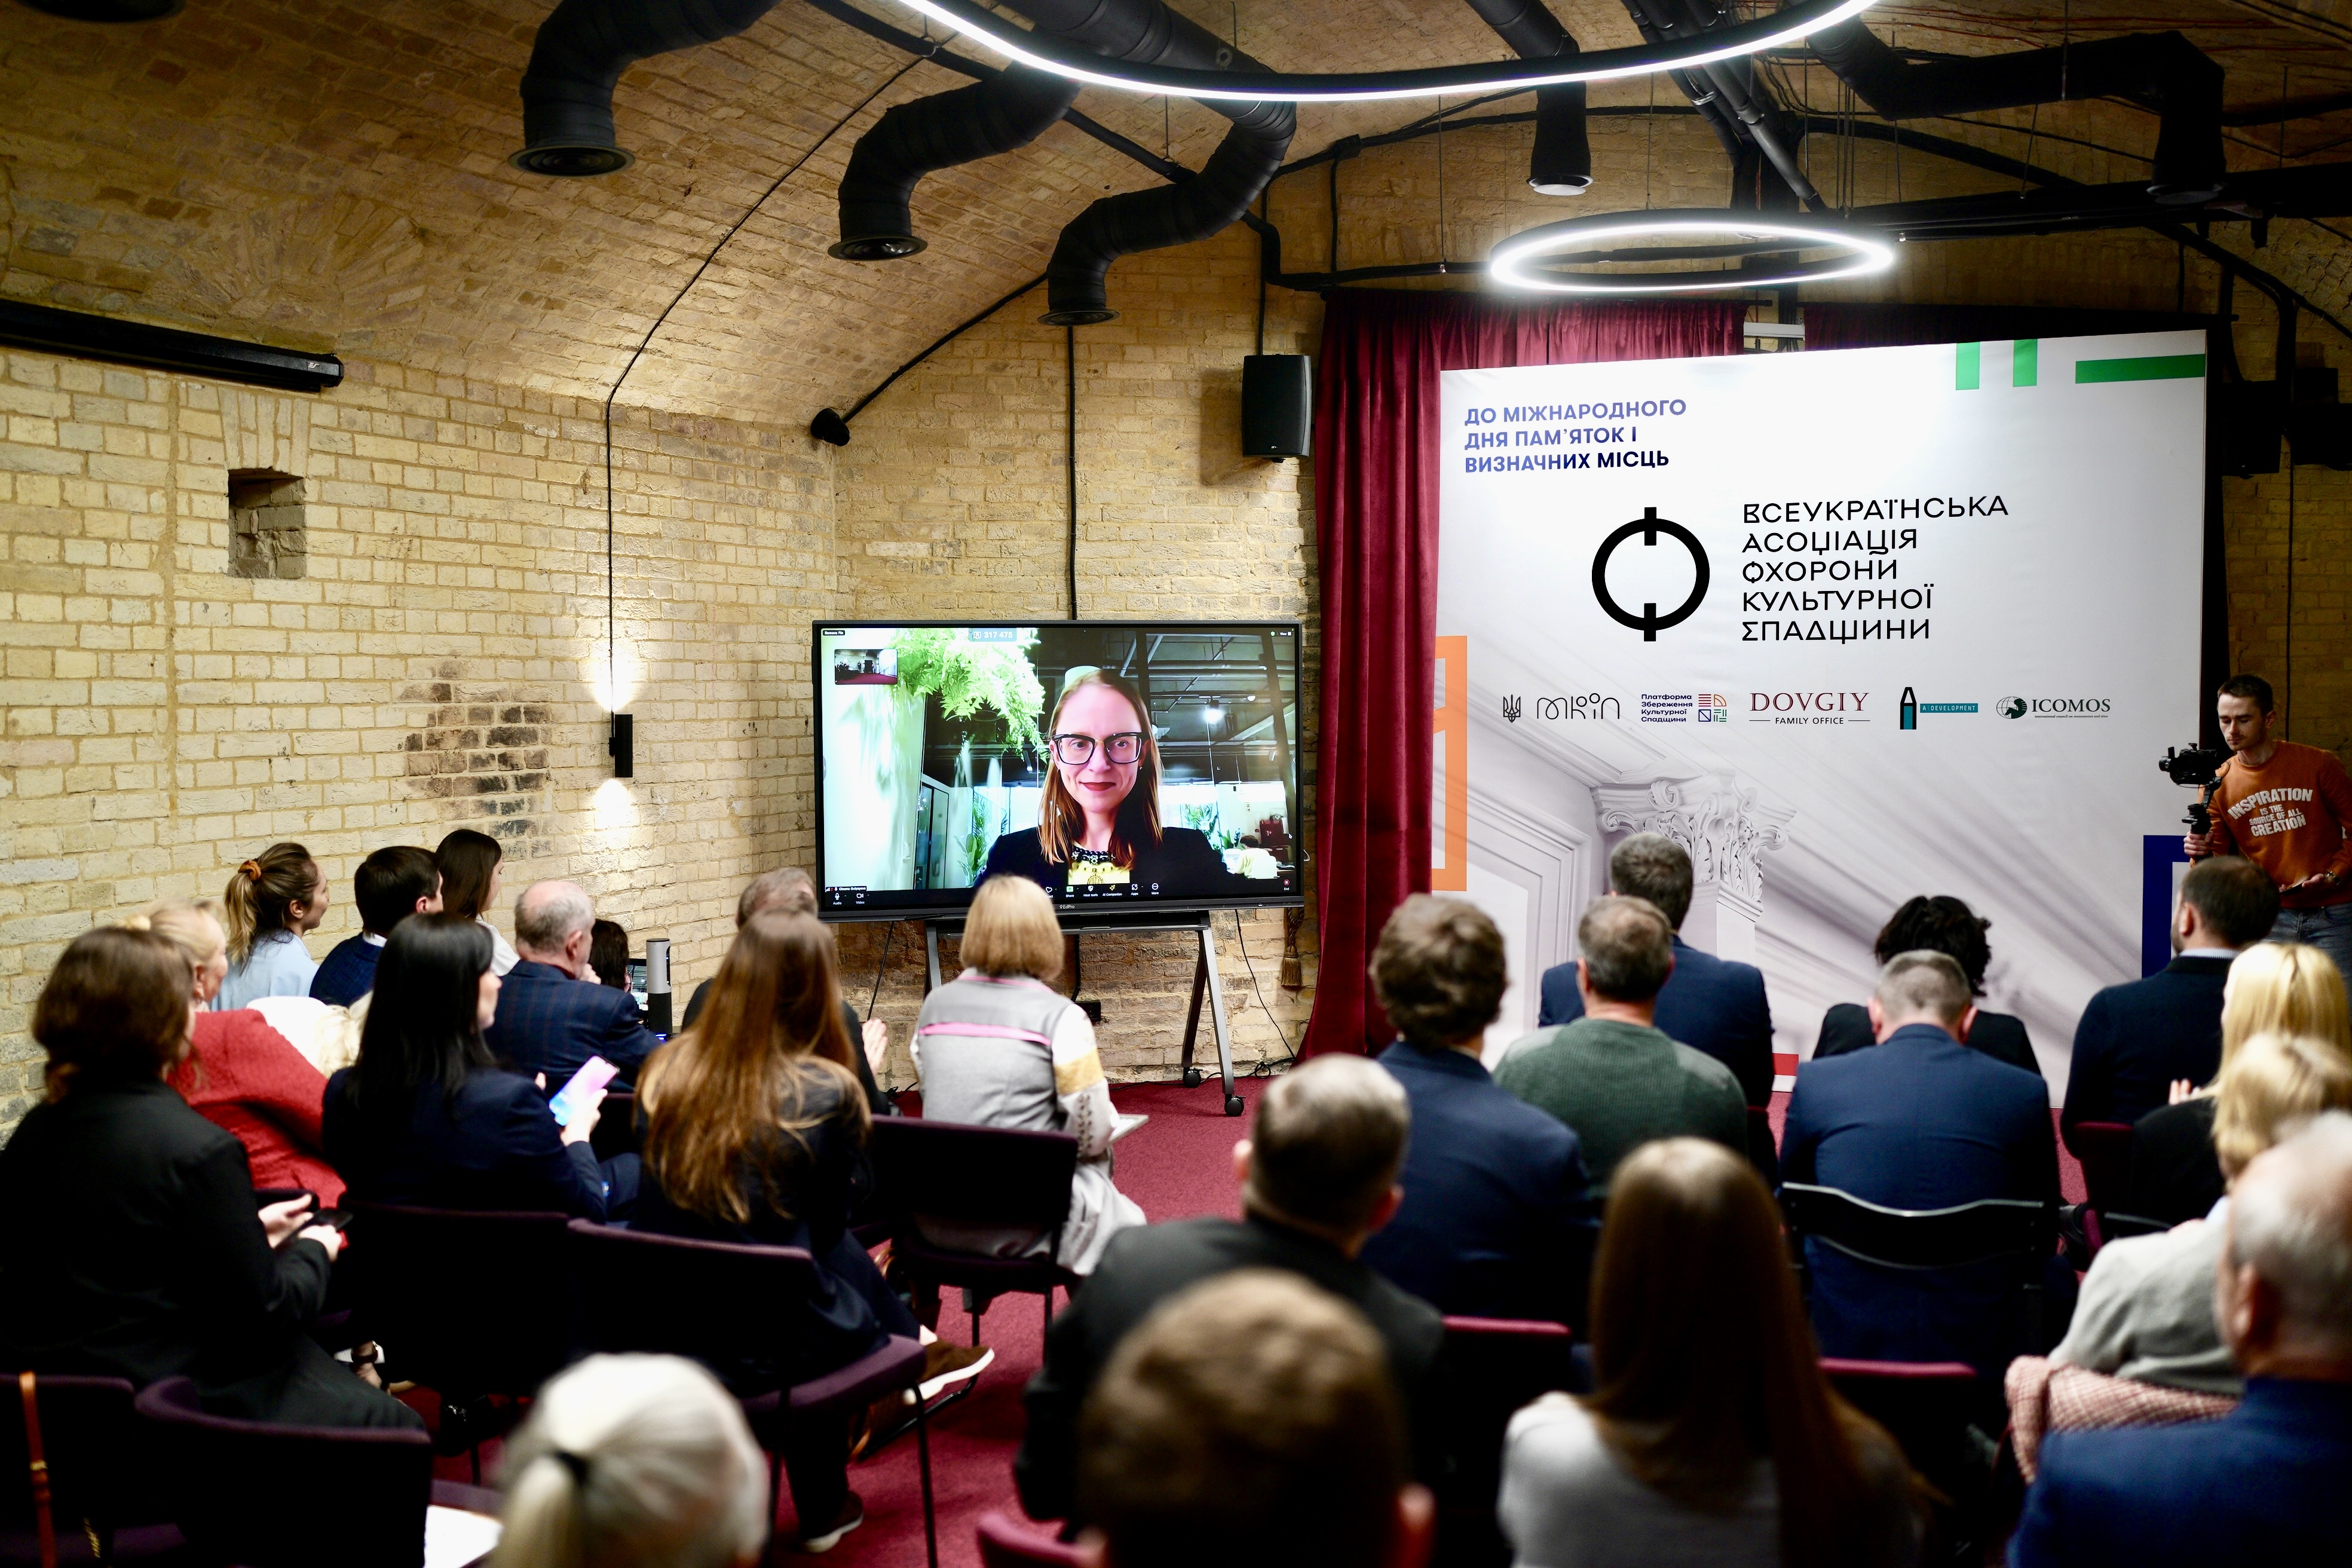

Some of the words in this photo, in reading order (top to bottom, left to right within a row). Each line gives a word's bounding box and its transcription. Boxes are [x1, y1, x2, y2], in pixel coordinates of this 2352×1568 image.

[1464, 408, 1496, 426] ДО
[1503, 399, 1686, 422] МІЖНАРОДНОГО
[1464, 432, 1508, 451] ДНЯ
[1465, 453, 1591, 473] ВИЗНАЧНИХ
[1597, 450, 1670, 468] МІСЦЬ
[1744, 495, 2009, 523] ВСЕУКРАЇНСЬКА
[1742, 529, 1917, 556] АСОЦІАЦІЯ
[1743, 583, 1934, 612] КУЛЬТУРНОЇ
[1750, 693, 1870, 712] DOVGIY
[2032, 699, 2111, 712] ICOMOS
[2227, 788, 2313, 820] INSPIRATION
[2269, 804, 2284, 813] THE
[2249, 814, 2276, 826] SOURCE
[2277, 811, 2286, 820] OF
[2288, 808, 2302, 818] ALL
[2250, 814, 2307, 837] CREATION
